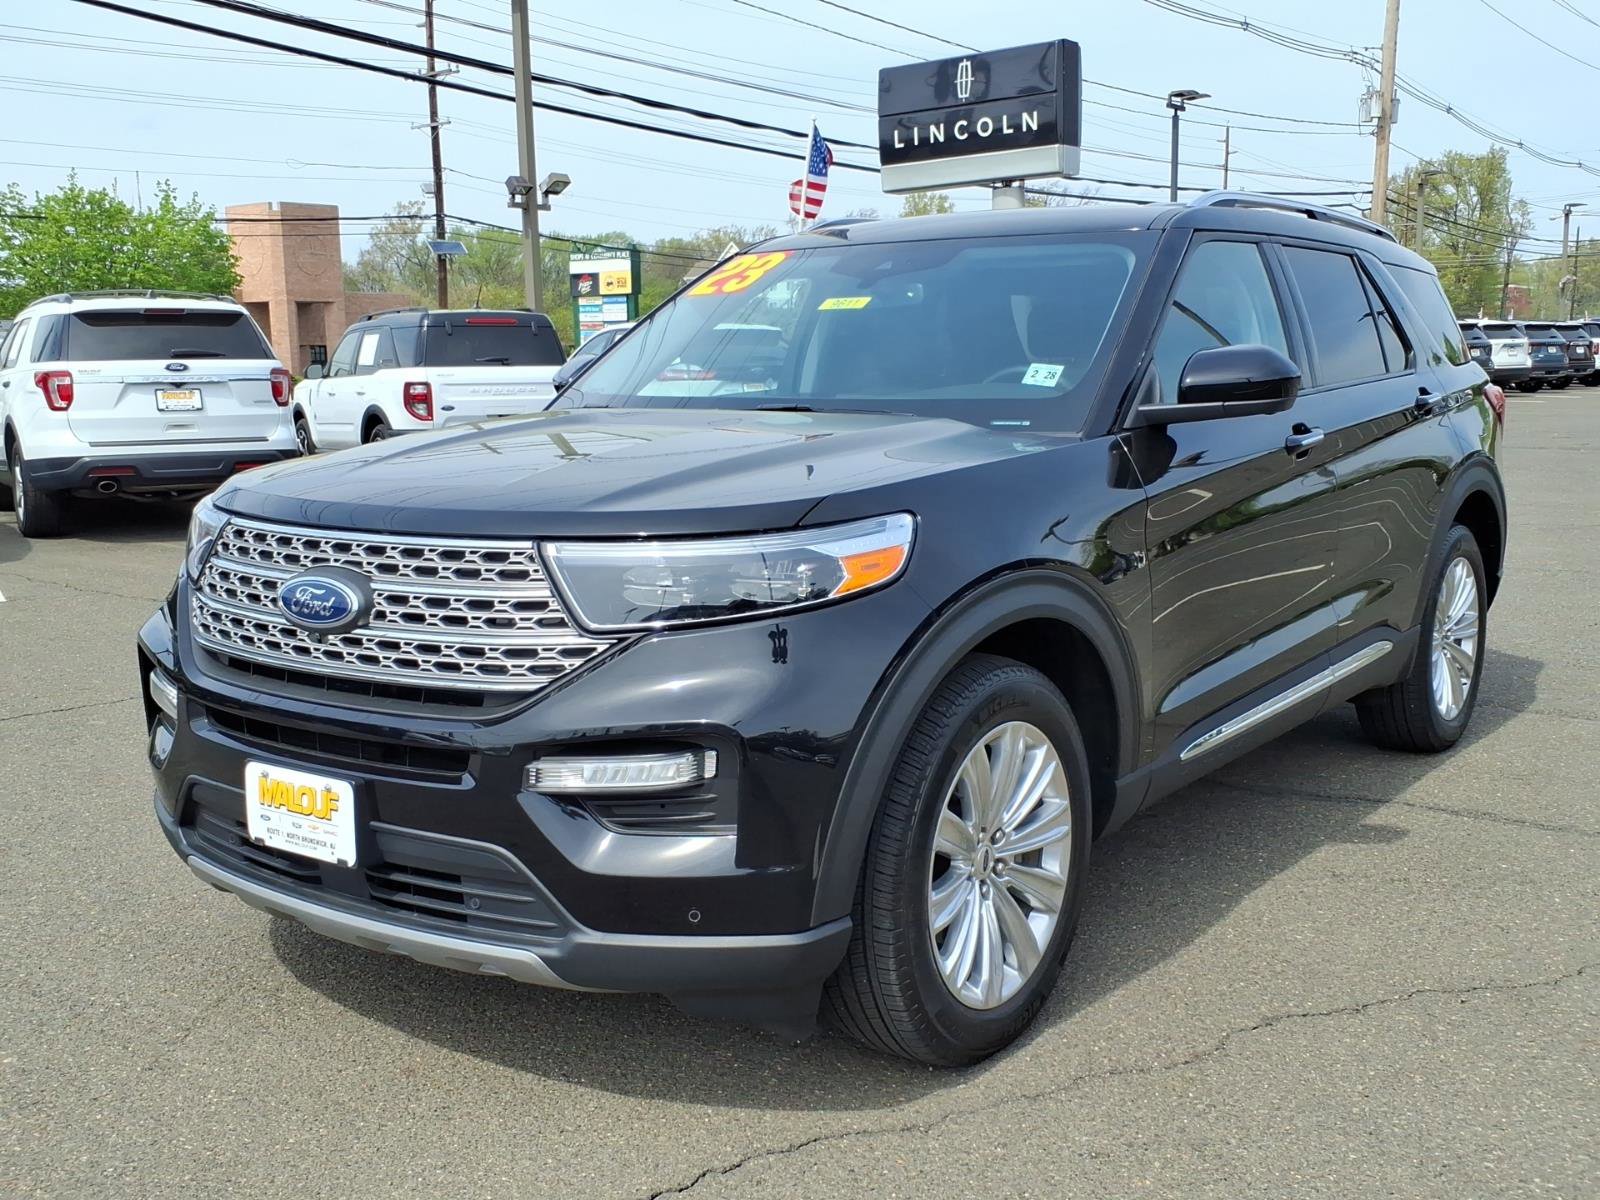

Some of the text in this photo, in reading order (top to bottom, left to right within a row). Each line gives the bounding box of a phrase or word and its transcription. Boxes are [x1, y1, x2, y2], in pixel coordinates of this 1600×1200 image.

[893, 111, 1038, 149] LINCOLN
[688, 252, 788, 296] 23
[1031, 369, 1058, 380] 2 28
[291, 586, 336, 617] Ford
[258, 775, 340, 821] MALOUF
[267, 827, 281, 837] ROUTE
[286, 831, 301, 841] NORTH
